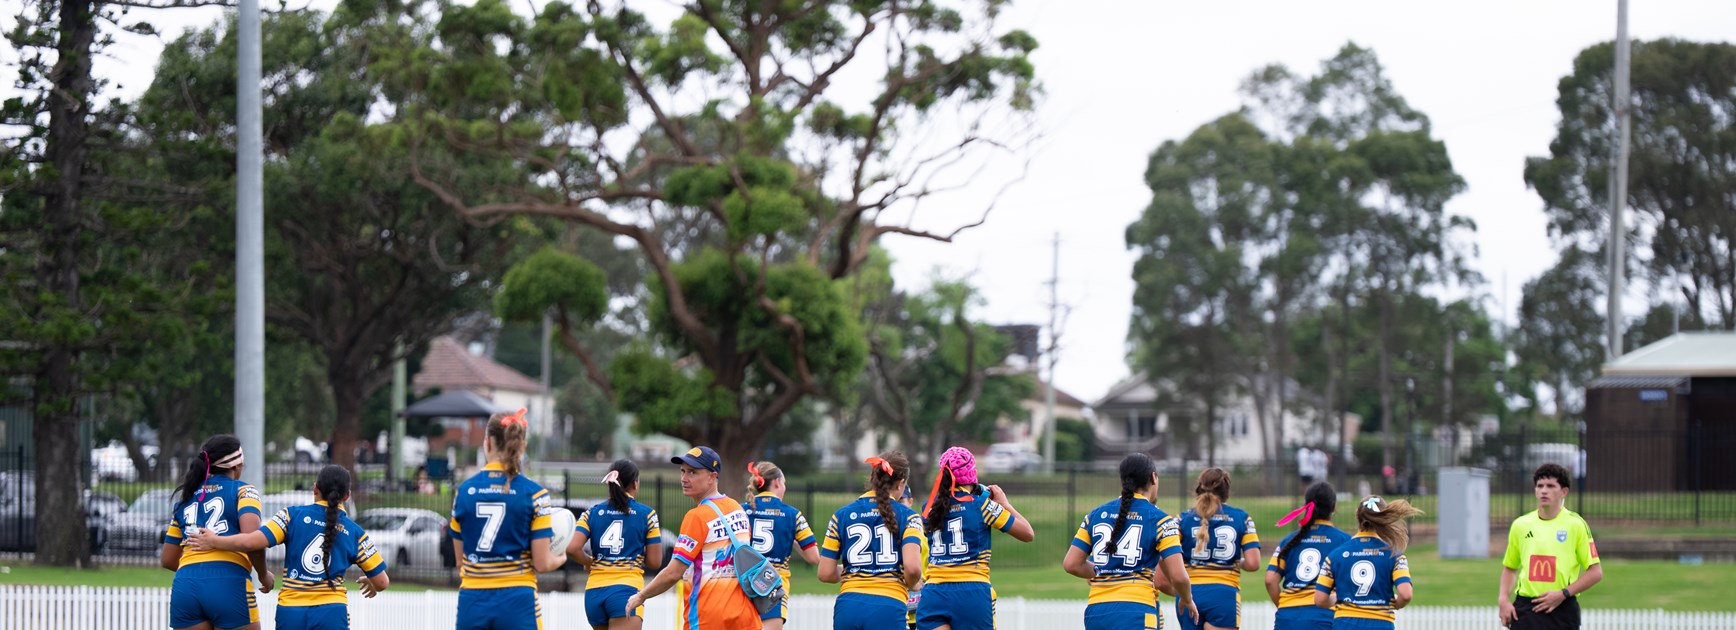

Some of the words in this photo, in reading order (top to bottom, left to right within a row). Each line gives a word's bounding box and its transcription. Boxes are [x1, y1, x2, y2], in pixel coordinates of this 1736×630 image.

[183, 496, 229, 536] 12
[475, 502, 507, 553] 7
[930, 516, 969, 556] 11
[301, 532, 332, 575] 6
[599, 519, 625, 555] 4
[751, 518, 775, 555] 5
[845, 523, 899, 567] 21
[1091, 522, 1144, 567] 24
[1190, 525, 1238, 561] 13
[1295, 547, 1322, 582] 8
[1349, 559, 1377, 597] 9
